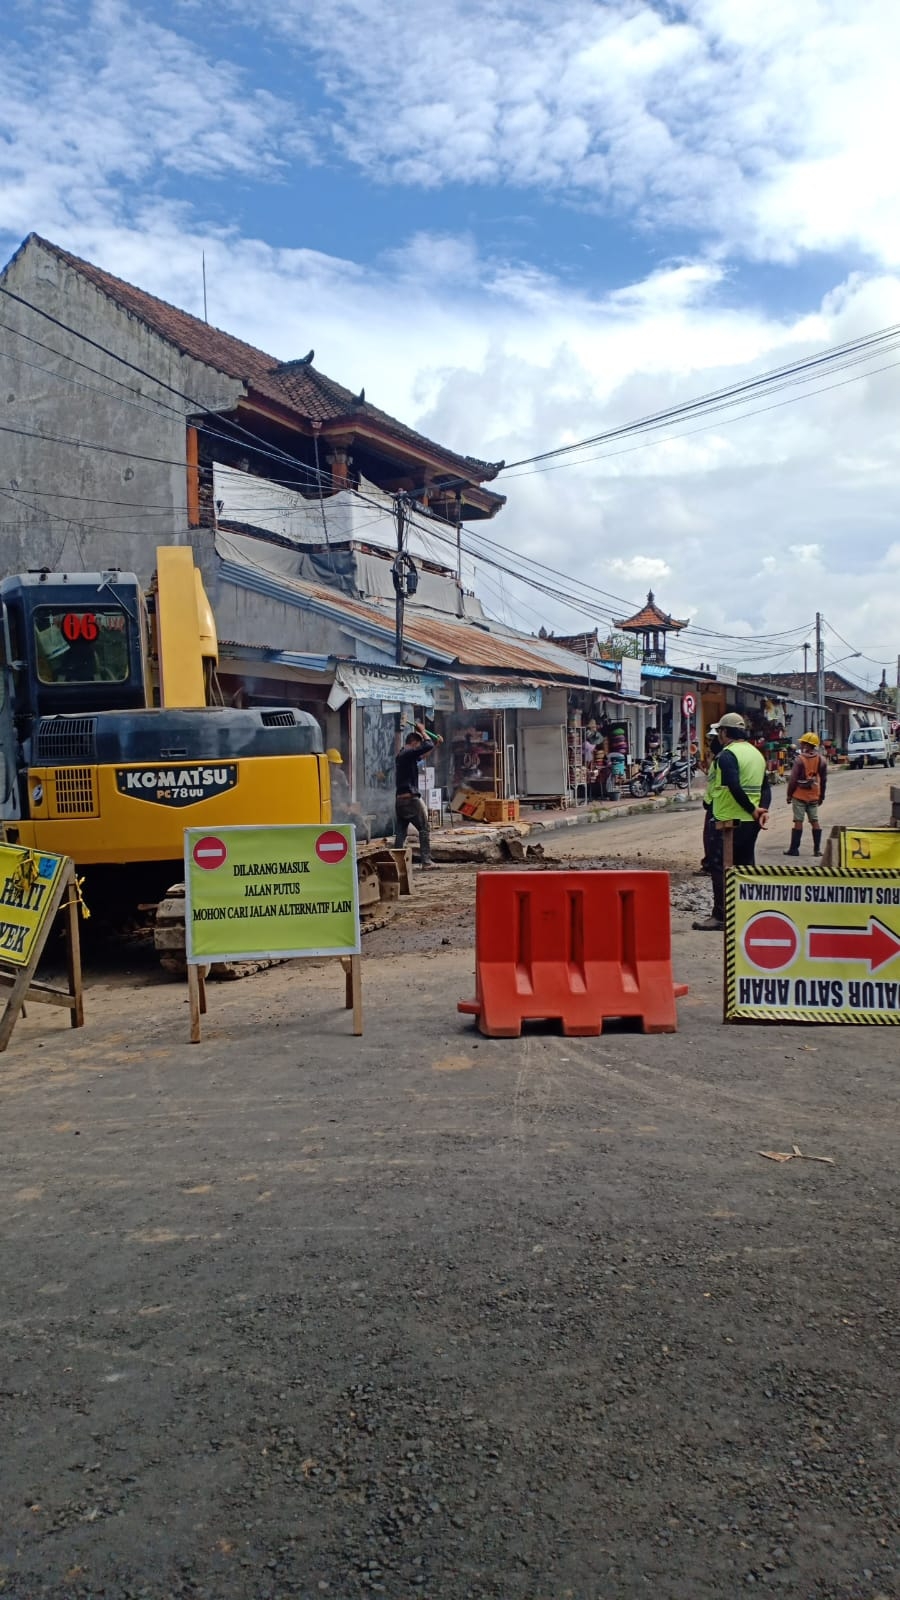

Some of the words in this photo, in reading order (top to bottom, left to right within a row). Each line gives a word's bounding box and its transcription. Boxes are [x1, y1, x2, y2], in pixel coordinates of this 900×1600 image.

[63, 612, 98, 641] 06
[126, 767, 228, 789] KOMATSU
[233, 863, 278, 877] DILARANG
[279, 861, 310, 875] MASUK
[244, 884, 272, 897] JALAN
[273, 882, 301, 896] PUTUS
[739, 883, 801, 901] DIALIHKAN
[805, 885, 873, 903] LALULINTAS
[876, 887, 900, 904] RUS
[193, 907, 226, 921] MOHON
[227, 906, 249, 919] CARI
[249, 904, 277, 918] JALAN
[278, 902, 330, 916] ALTERNATIF
[331, 900, 352, 913] LAIN
[739, 978, 790, 1005] ARAH
[794, 979, 843, 1008] SATU
[848, 981, 900, 1008] ALUR
